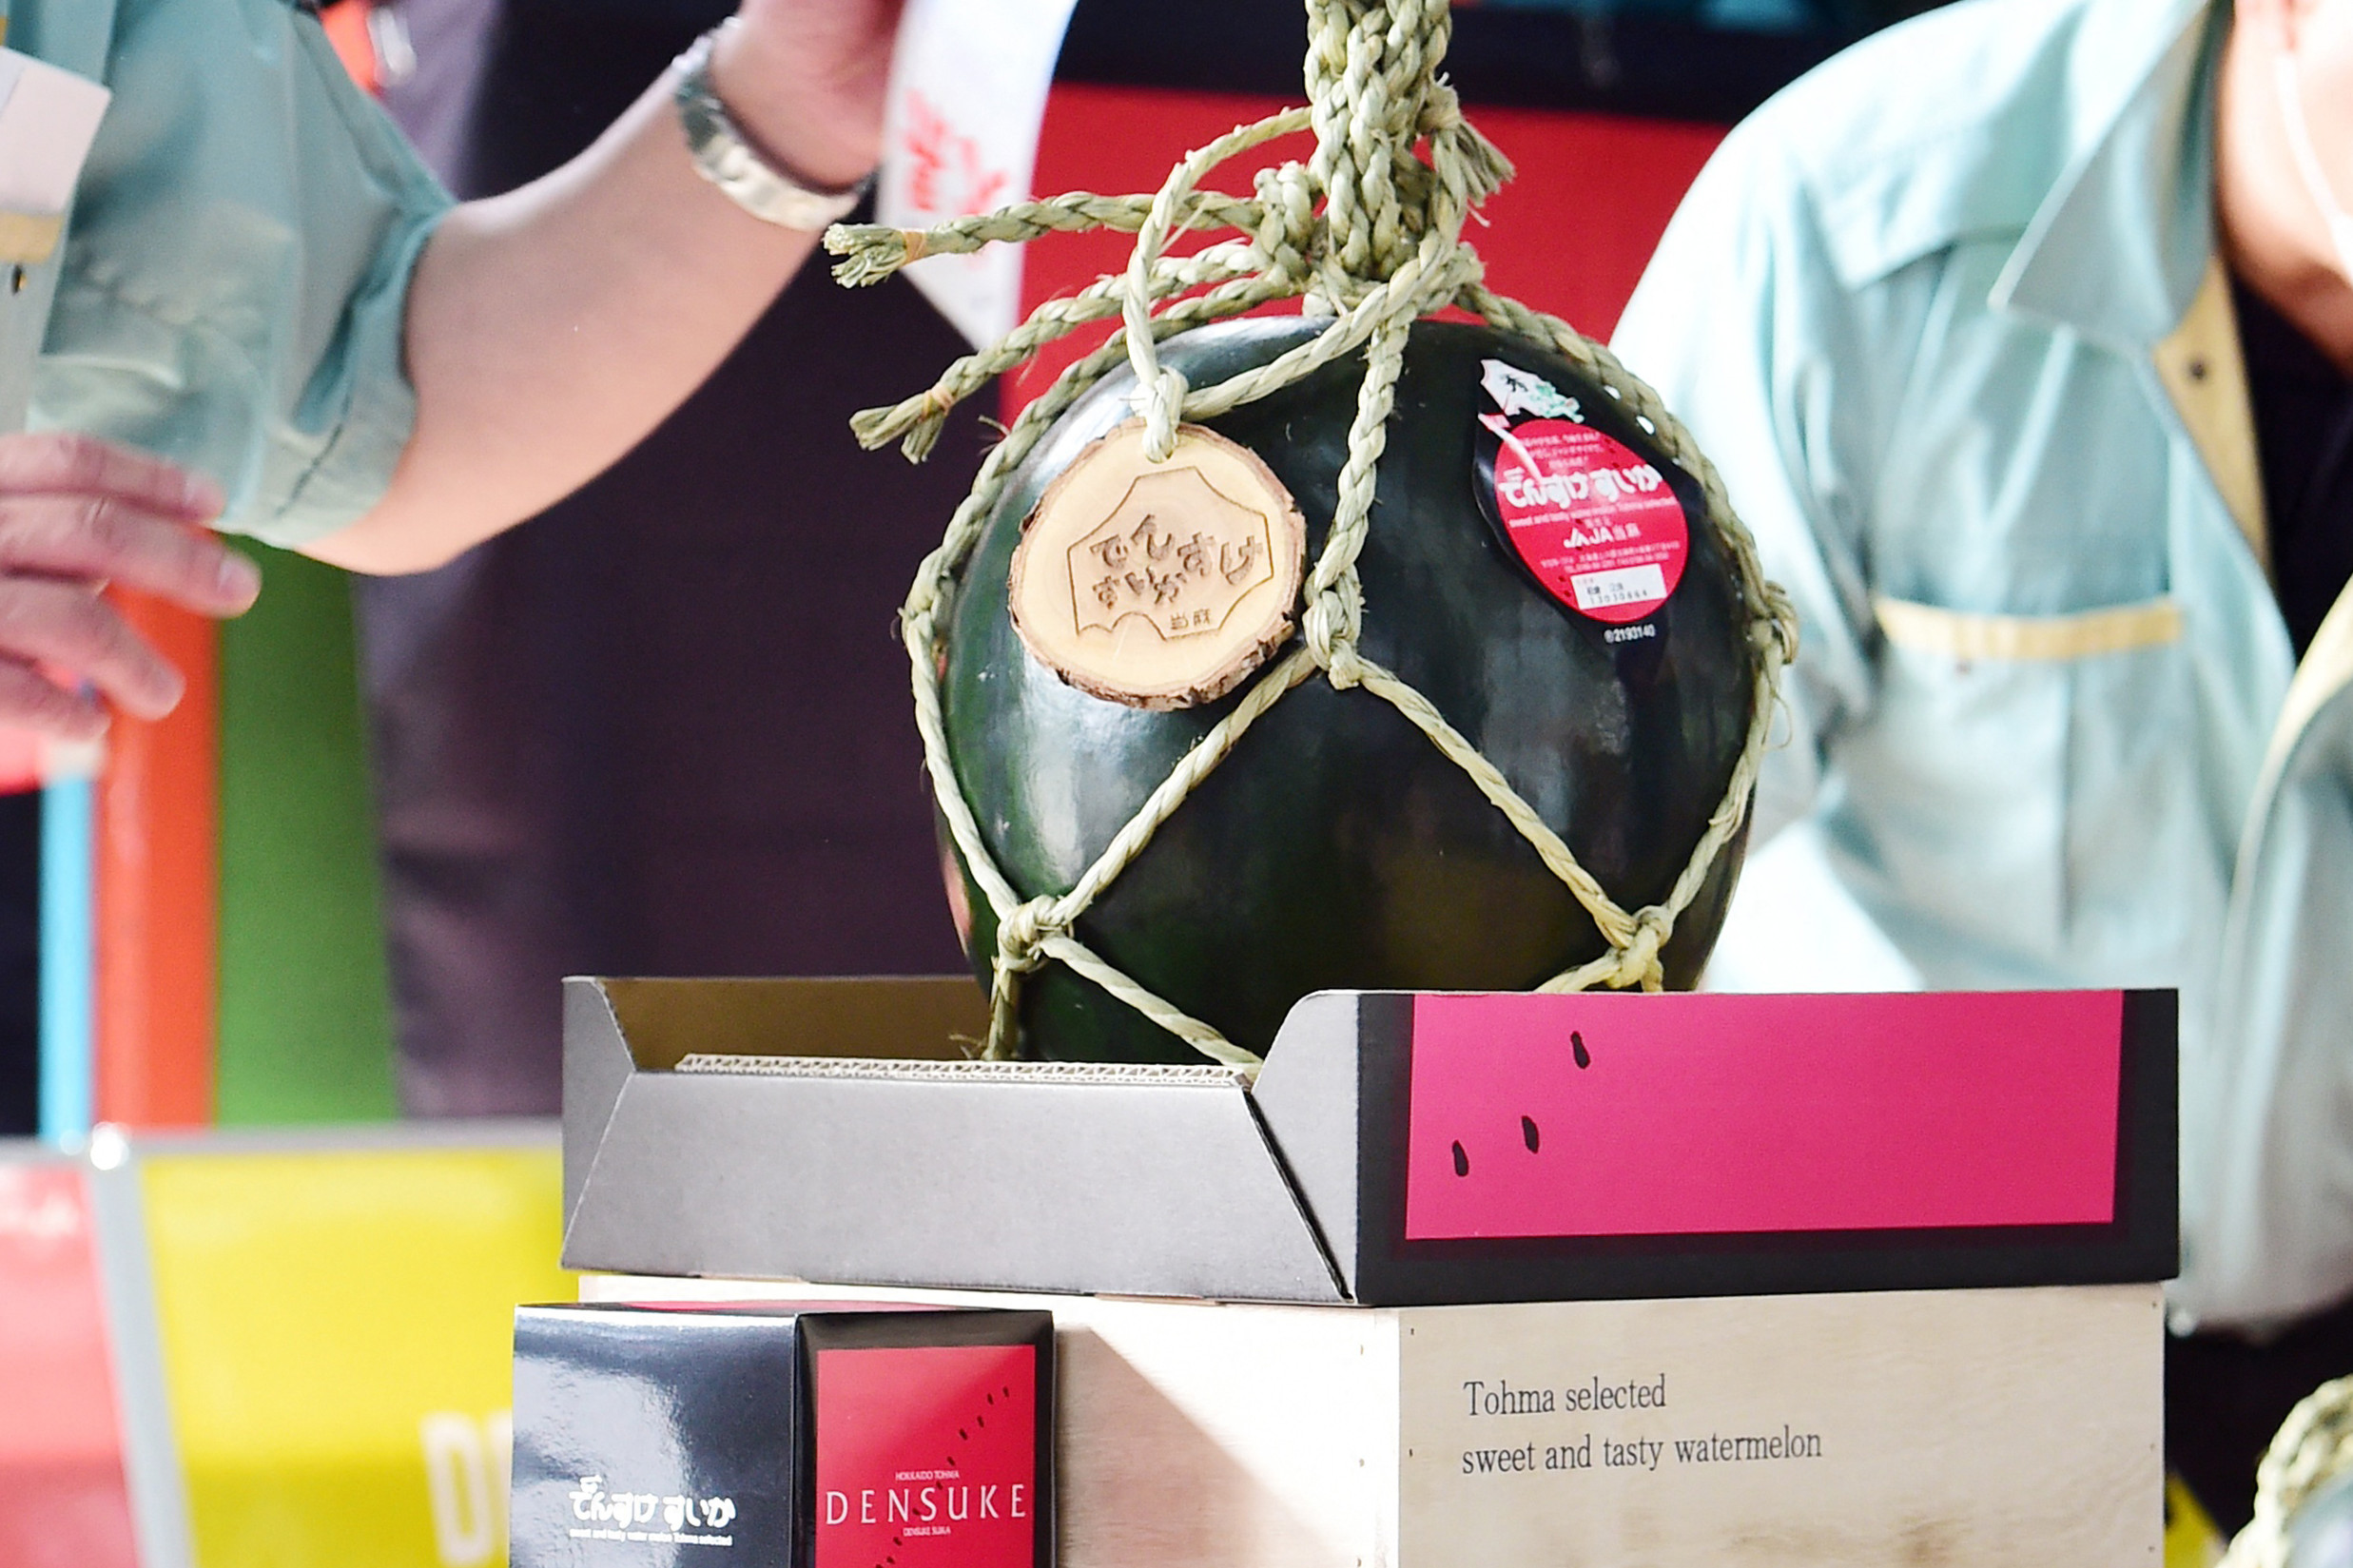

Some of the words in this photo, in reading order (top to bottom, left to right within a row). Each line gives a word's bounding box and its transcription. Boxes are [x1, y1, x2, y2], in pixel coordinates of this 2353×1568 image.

[1463, 1380, 1556, 1417] Tohma
[1565, 1372, 1666, 1412] selected
[1462, 1440, 1536, 1475] sweet
[1545, 1433, 1592, 1471] and
[1603, 1436, 1664, 1472] tasty
[1674, 1424, 1823, 1463] watermelon
[826, 1483, 1026, 1525] DENSUKE
